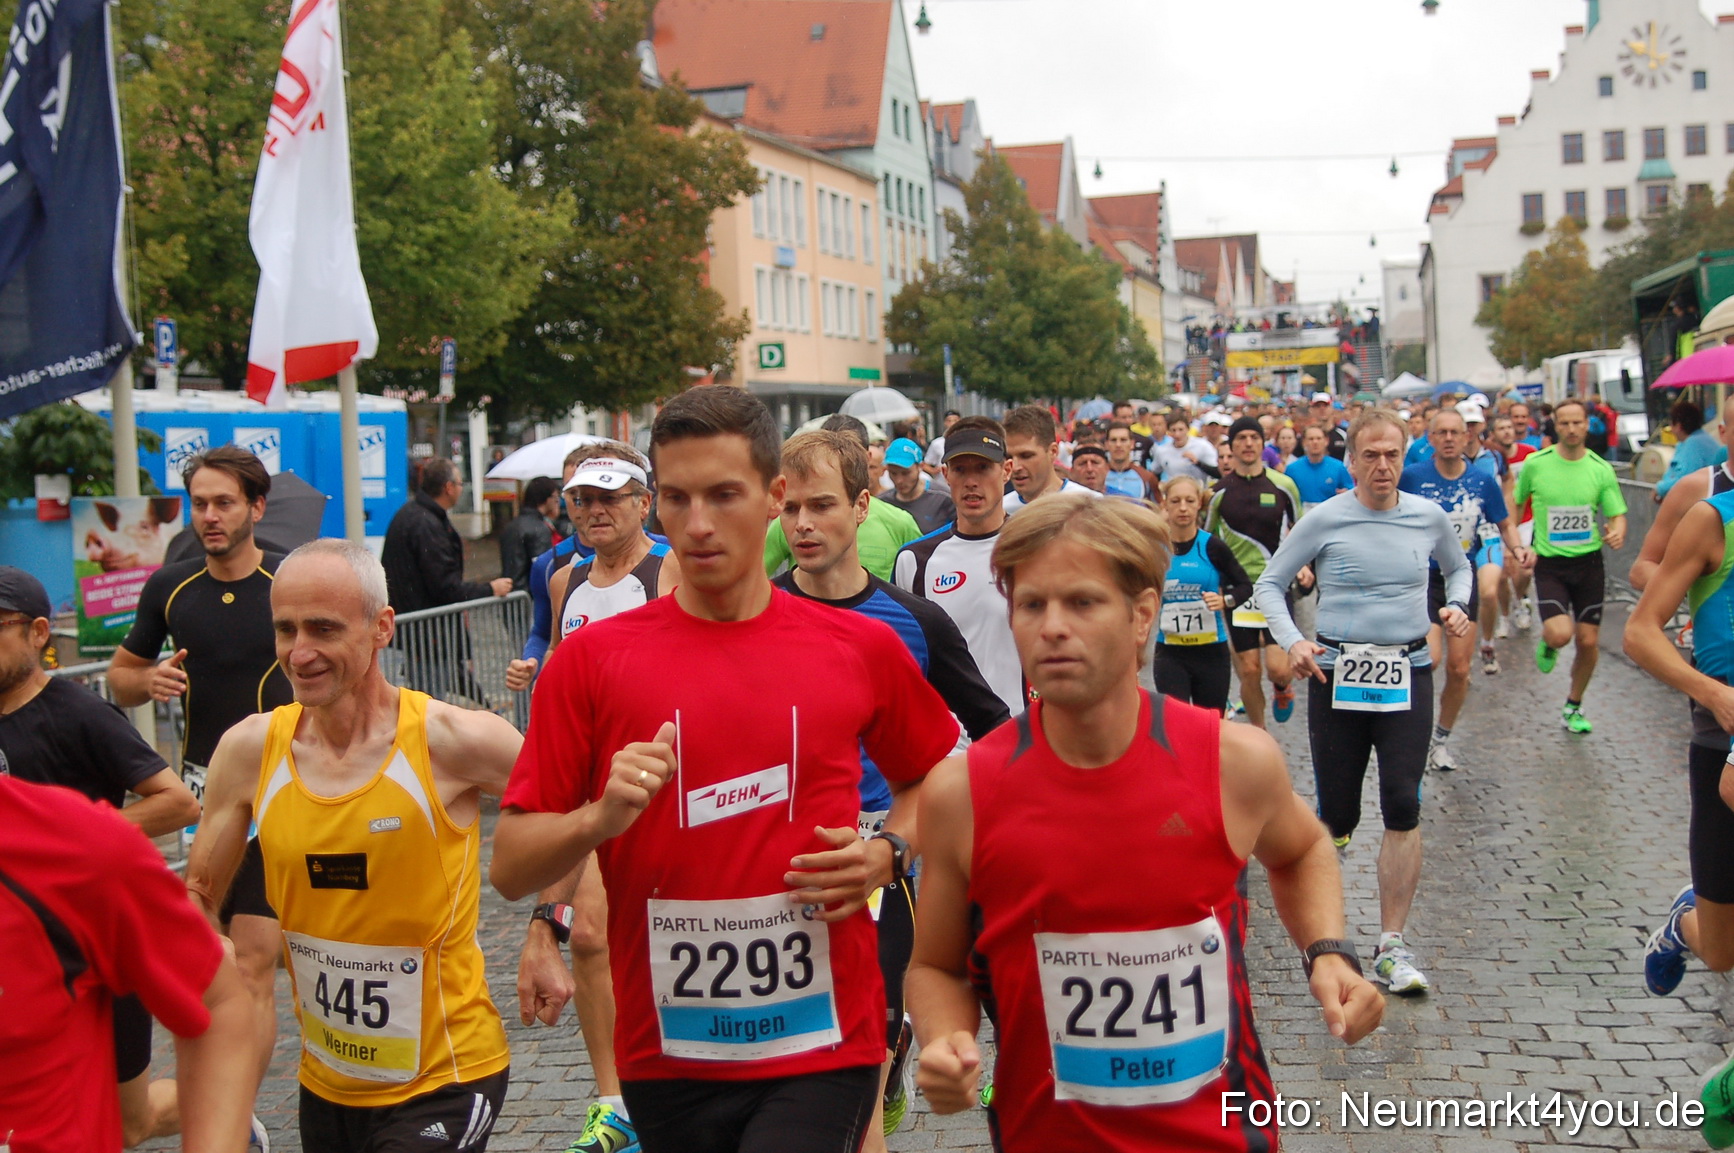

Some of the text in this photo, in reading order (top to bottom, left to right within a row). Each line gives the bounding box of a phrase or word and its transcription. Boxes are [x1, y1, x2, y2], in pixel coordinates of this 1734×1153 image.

[760, 345, 782, 367] D
[1552, 515, 1589, 531] 2228
[935, 574, 957, 586] tkn
[565, 619, 582, 630] tkn
[1172, 613, 1203, 633] 171
[1343, 659, 1402, 685] 2225
[1361, 690, 1383, 701] Uwe
[716, 782, 761, 809] DEHN
[652, 909, 796, 932] PARTL Neumarkt
[289, 941, 395, 973] PARTL Neumarkt
[669, 930, 815, 999] 2293
[1041, 942, 1194, 967] PARTL Neumarkt
[314, 970, 391, 1030] 445
[1061, 964, 1206, 1039] 2241
[708, 1014, 785, 1042] Jürgen
[322, 1027, 378, 1062] Werner
[1110, 1057, 1176, 1081] Peter
[420, 1131, 450, 1140] adidas
